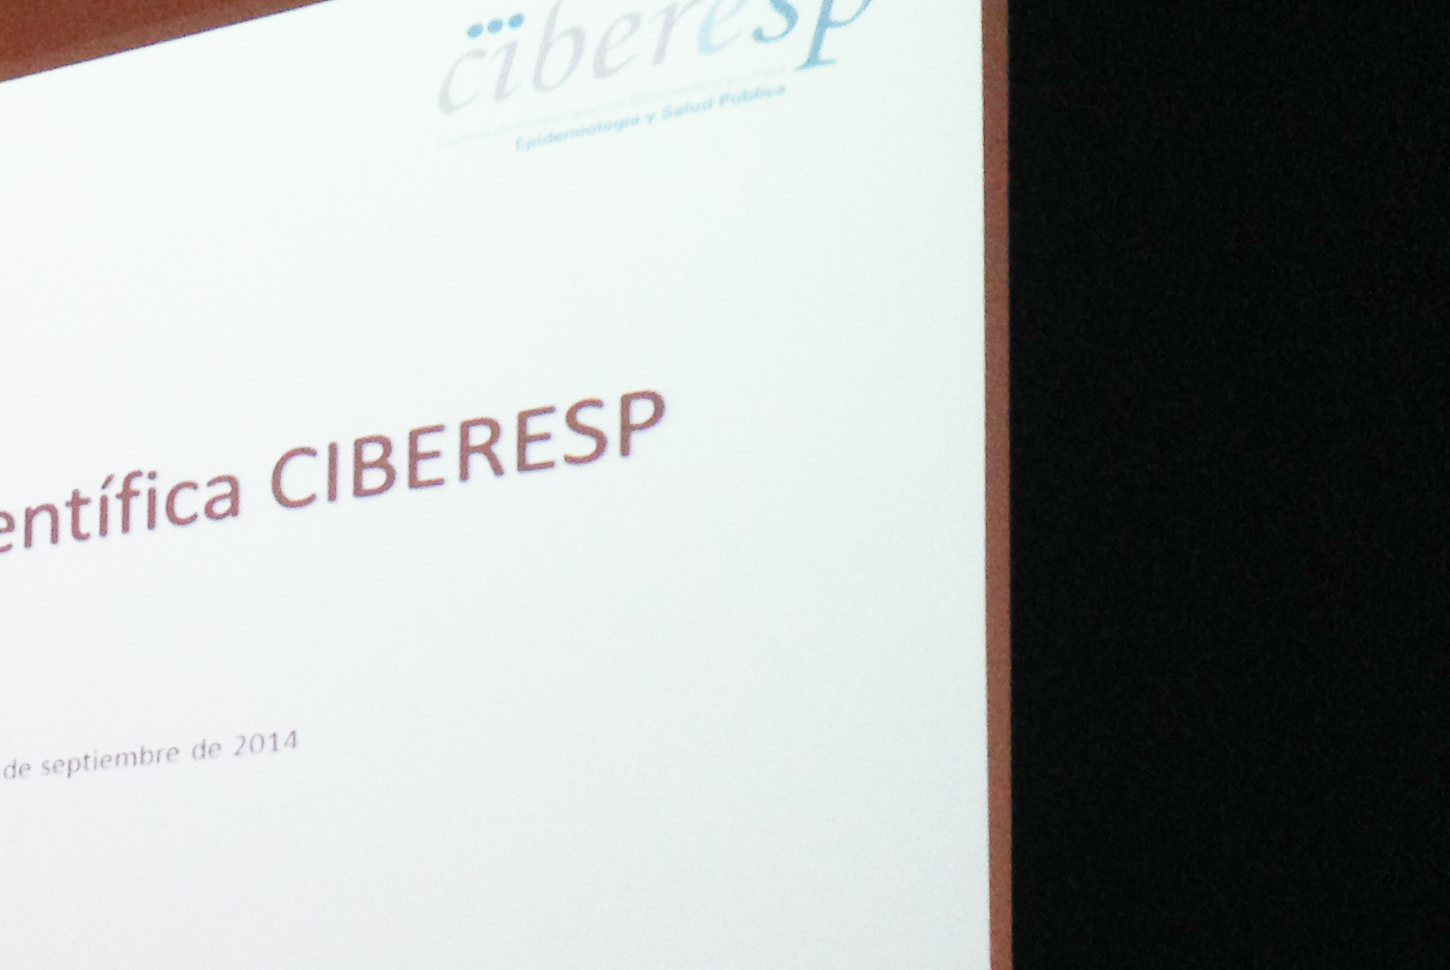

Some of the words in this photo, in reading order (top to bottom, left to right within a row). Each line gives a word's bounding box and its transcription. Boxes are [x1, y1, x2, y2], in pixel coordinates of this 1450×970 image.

[661, 97, 714, 120] Salud
[270, 389, 667, 510] CIBERESP
[3, 757, 32, 779] de
[40, 744, 180, 780] septiembre
[191, 737, 223, 760] de
[233, 729, 299, 756] 2014
